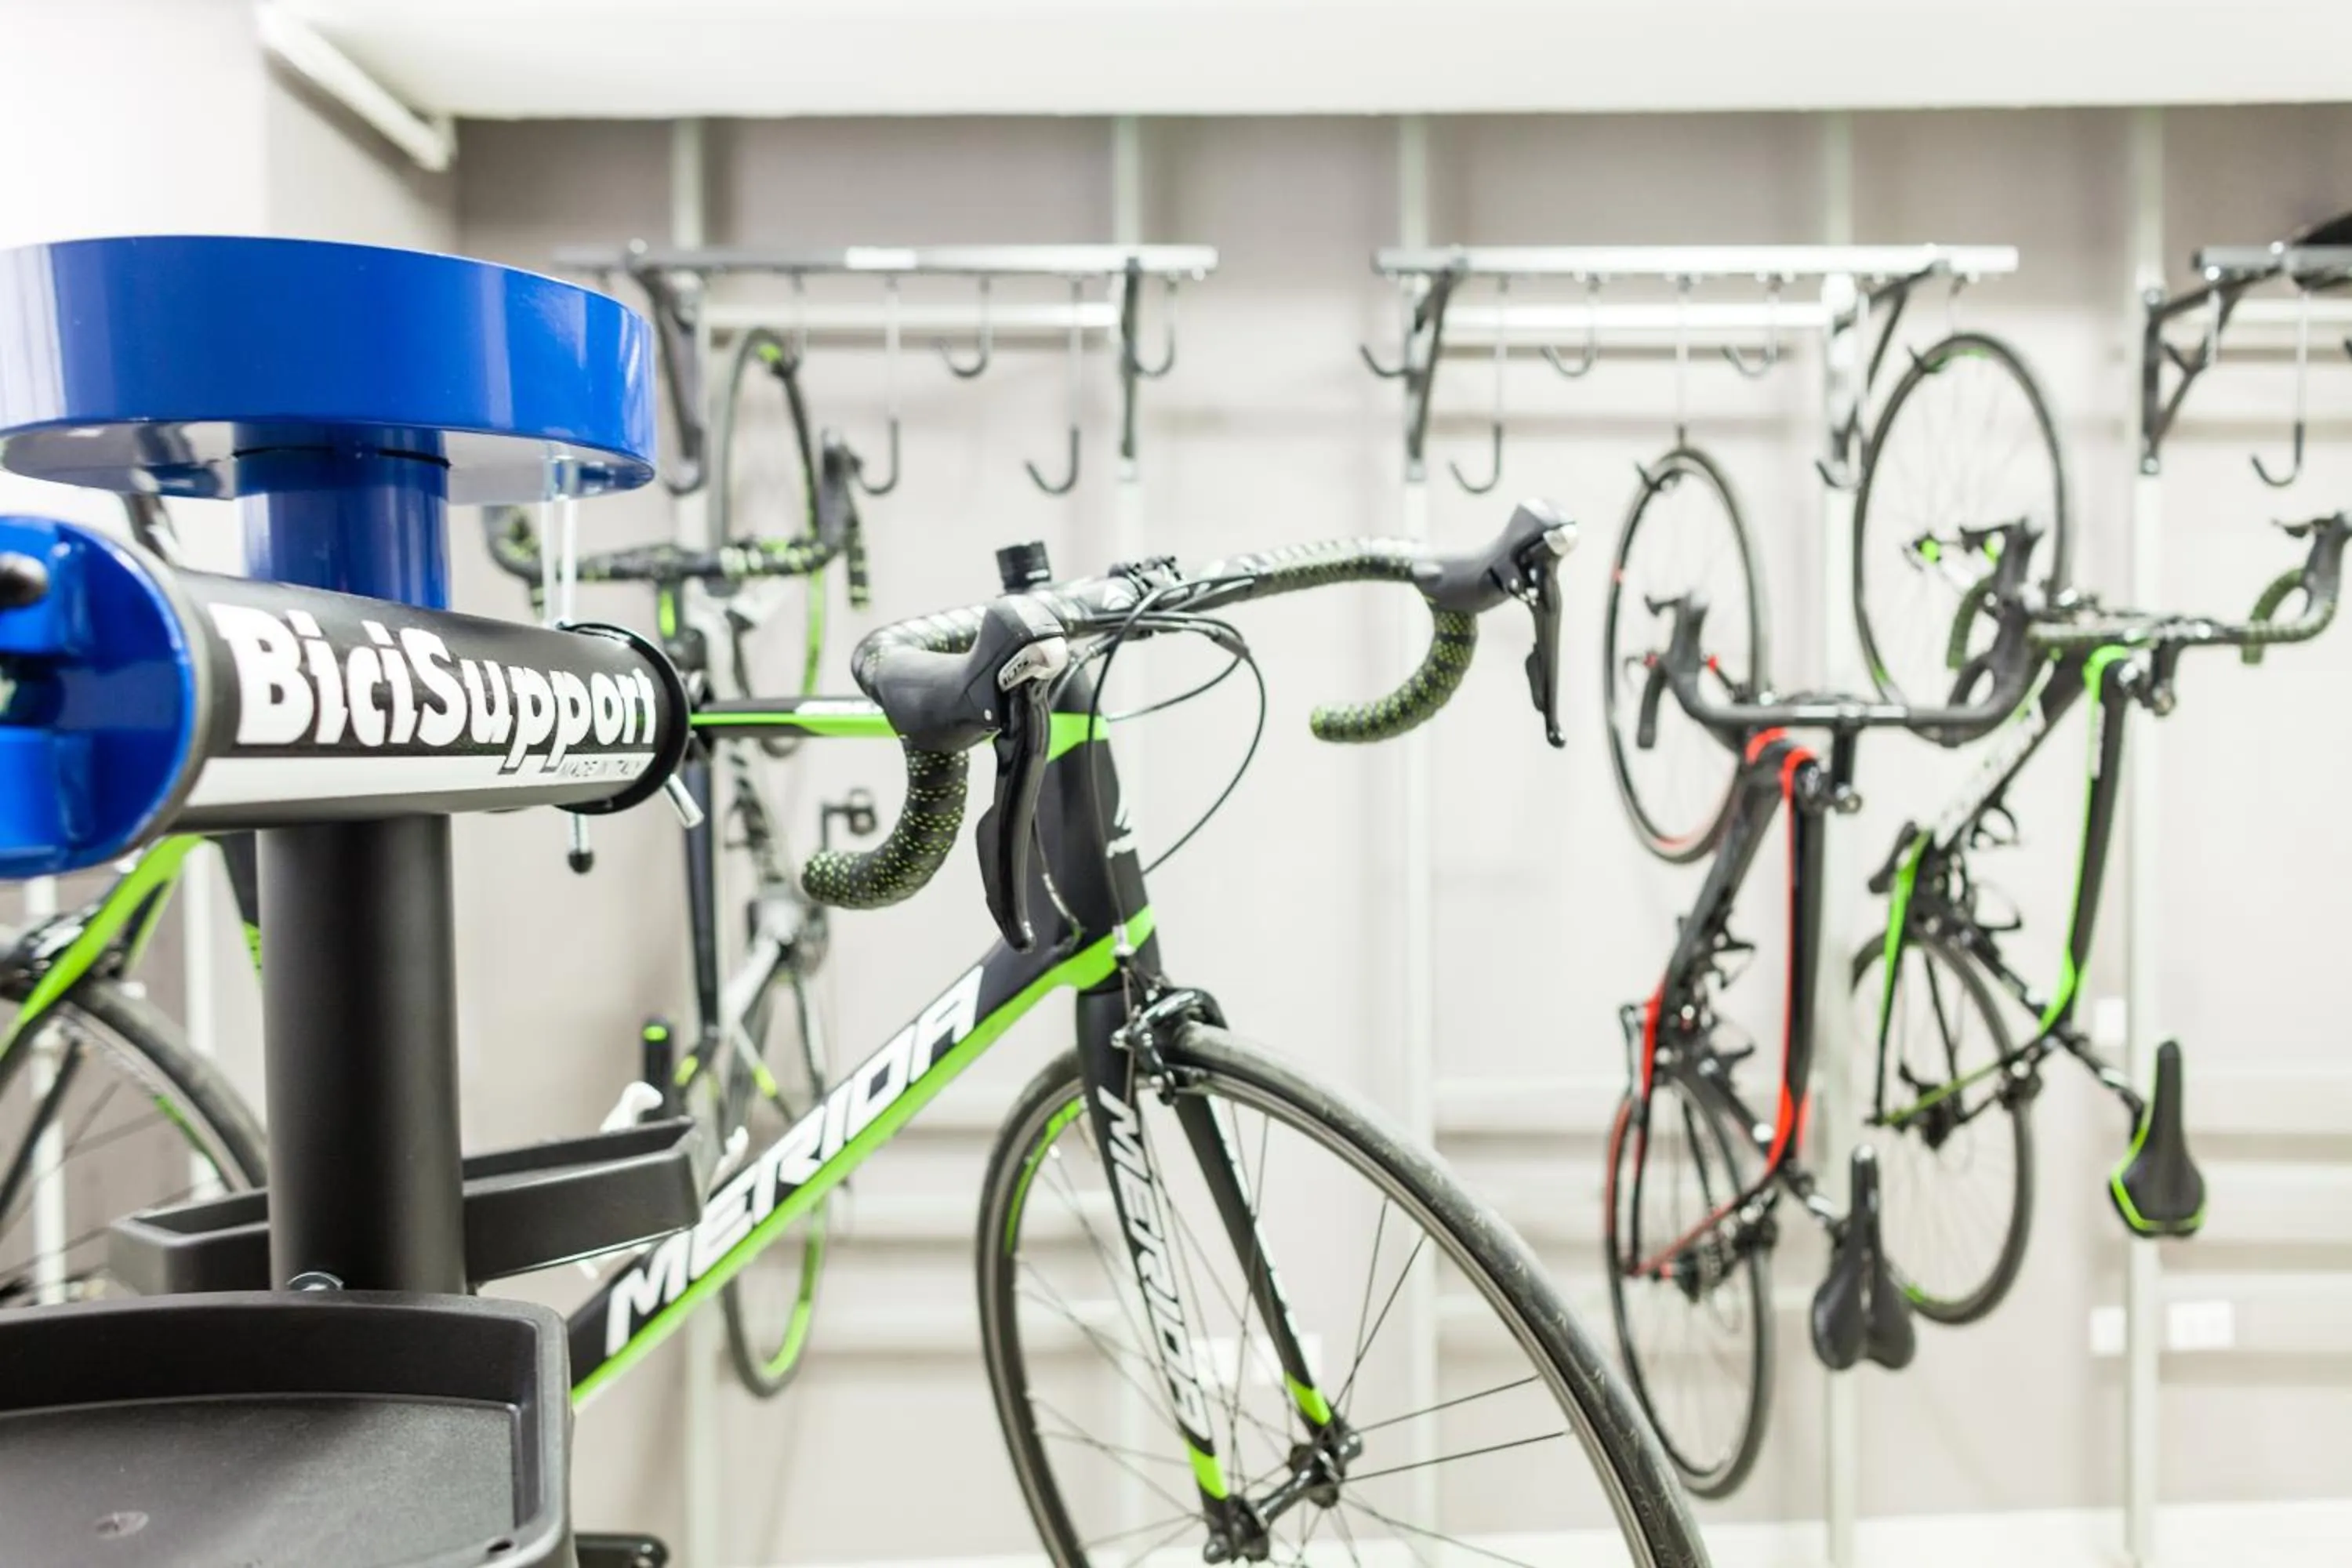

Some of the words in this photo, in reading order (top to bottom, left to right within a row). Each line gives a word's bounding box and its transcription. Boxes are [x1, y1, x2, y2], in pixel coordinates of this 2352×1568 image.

[208, 602, 656, 768] BiciSupport
[606, 965, 984, 1358] MERIDA
[1098, 1085, 1211, 1440] MERIDA
